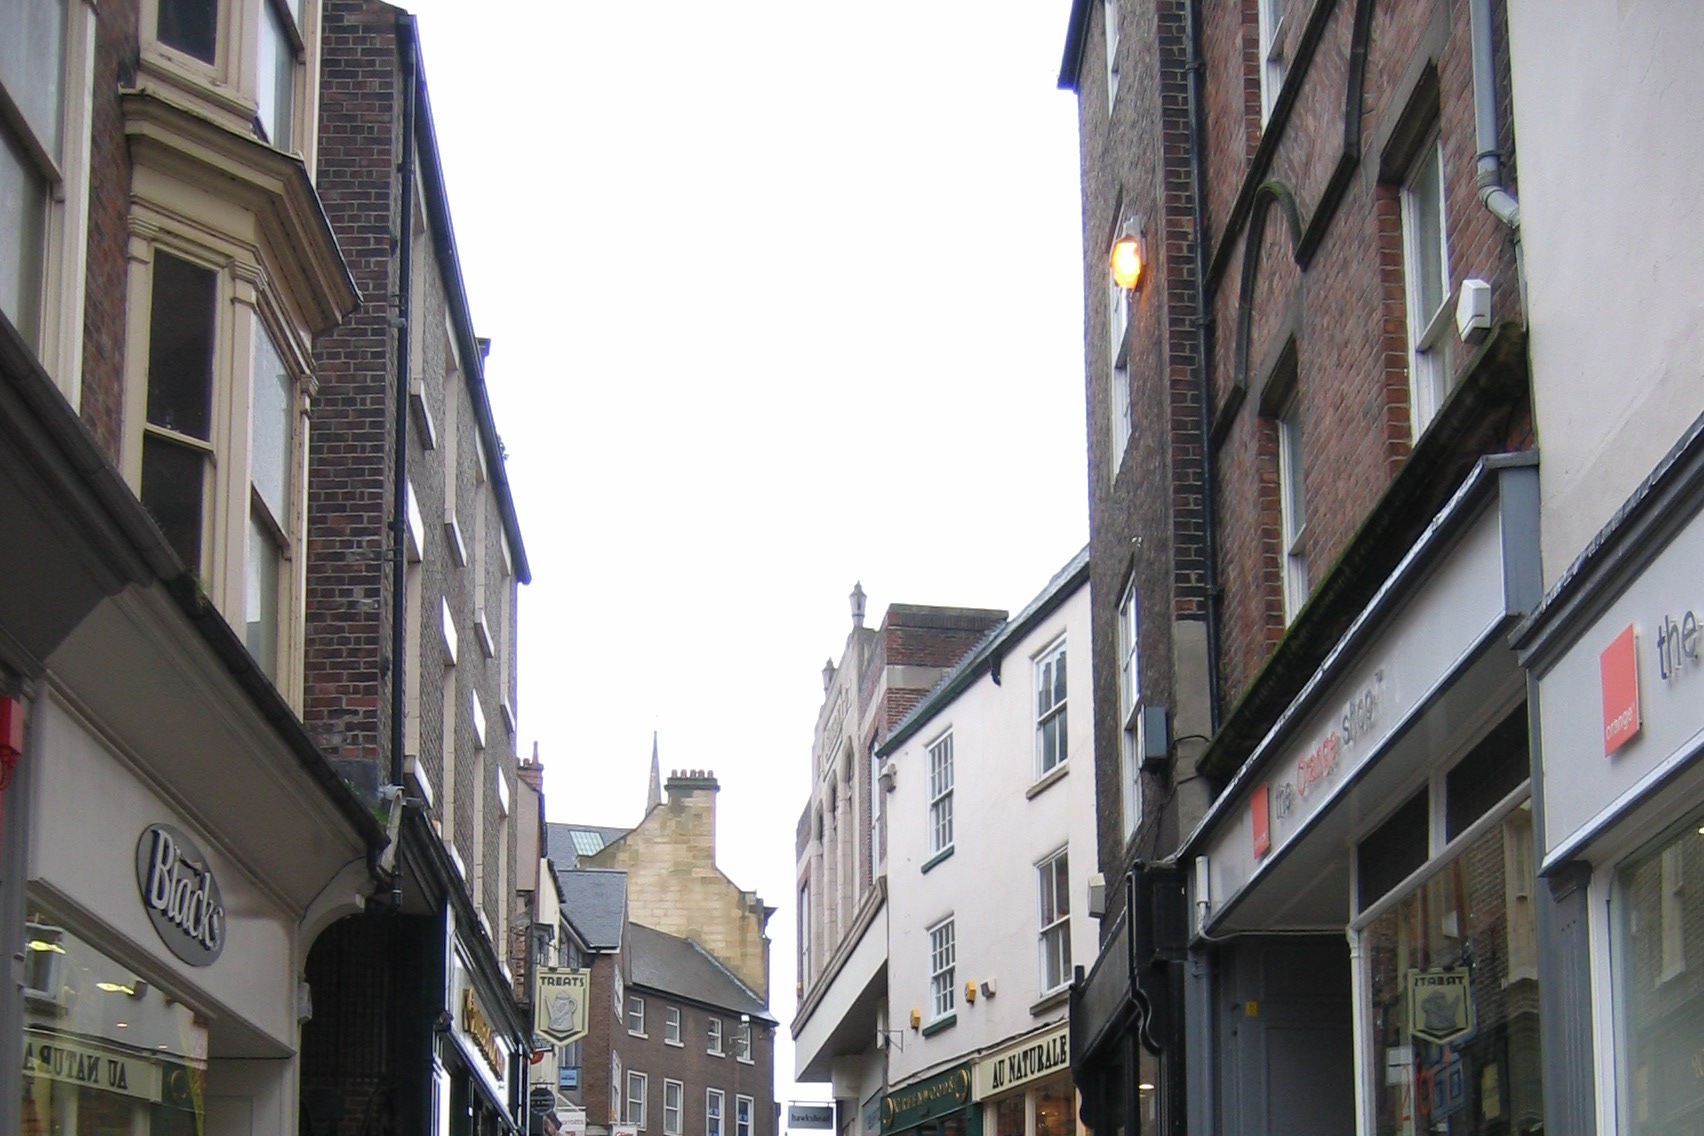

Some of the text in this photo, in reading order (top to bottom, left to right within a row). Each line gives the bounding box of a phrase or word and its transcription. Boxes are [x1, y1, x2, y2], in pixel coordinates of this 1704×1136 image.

[1657, 610, 1697, 680] the
[1605, 705, 1634, 740] orange
[147, 828, 224, 951] Blacks
[540, 976, 585, 988] TREATS
[992, 1034, 1067, 1090] AU NATURALE
